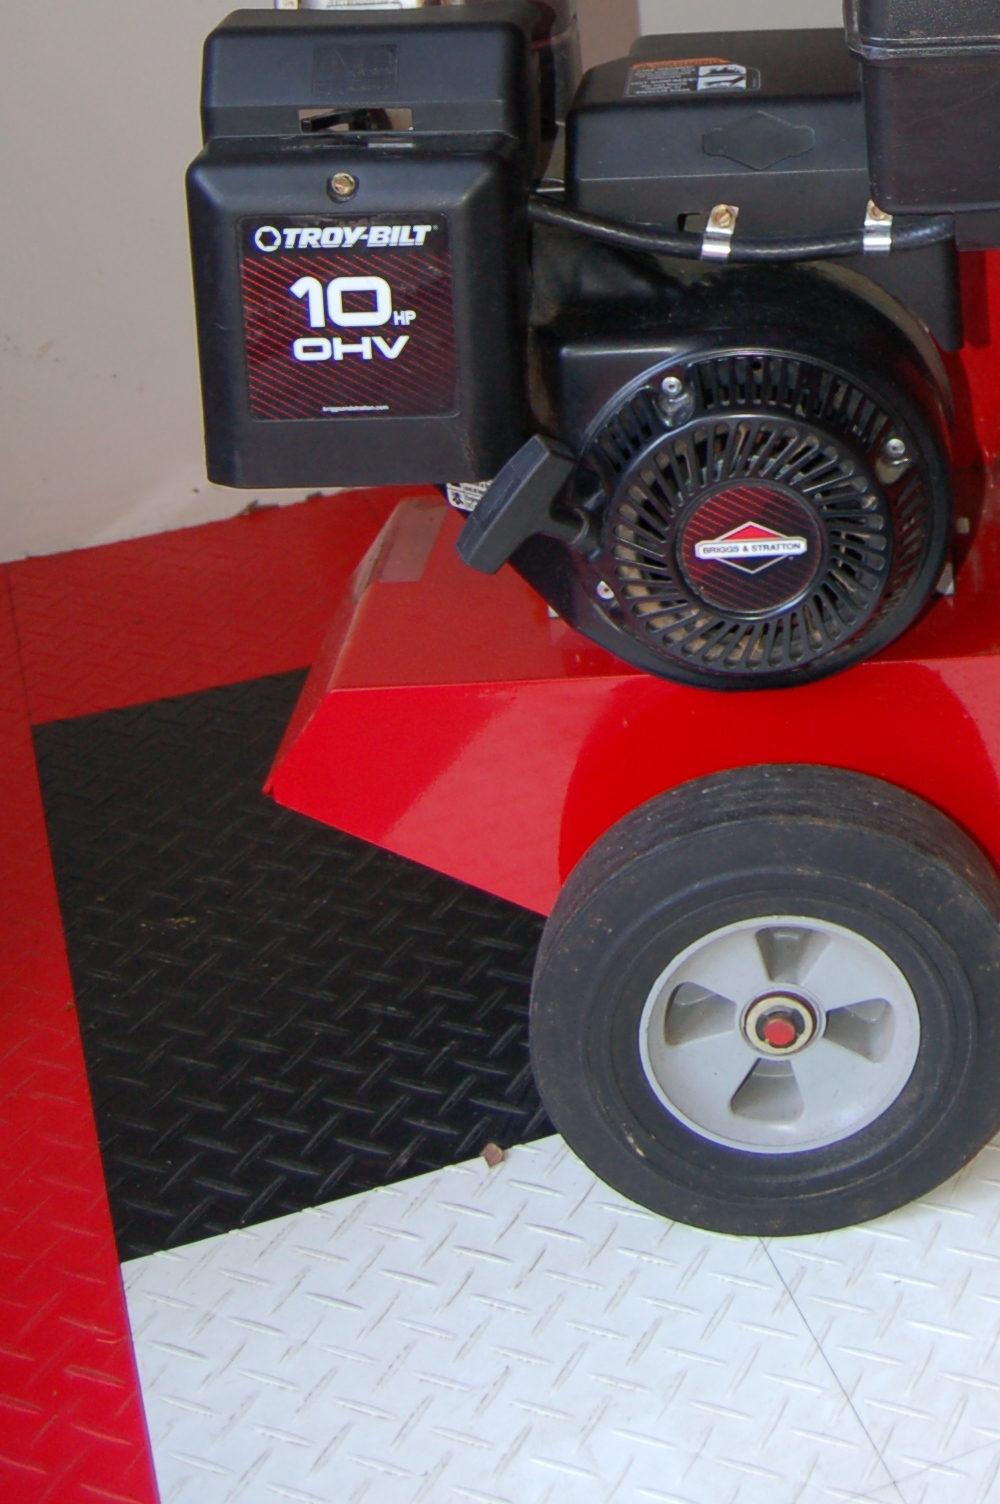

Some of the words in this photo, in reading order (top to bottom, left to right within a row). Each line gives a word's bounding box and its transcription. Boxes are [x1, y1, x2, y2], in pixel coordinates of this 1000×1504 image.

[282, 225, 432, 249] TROY-BILT
[288, 276, 393, 328] 10
[393, 310, 417, 326] HP
[292, 335, 410, 362] OHV
[702, 545, 740, 554] BRIGGS
[751, 542, 801, 553] STRATTON
